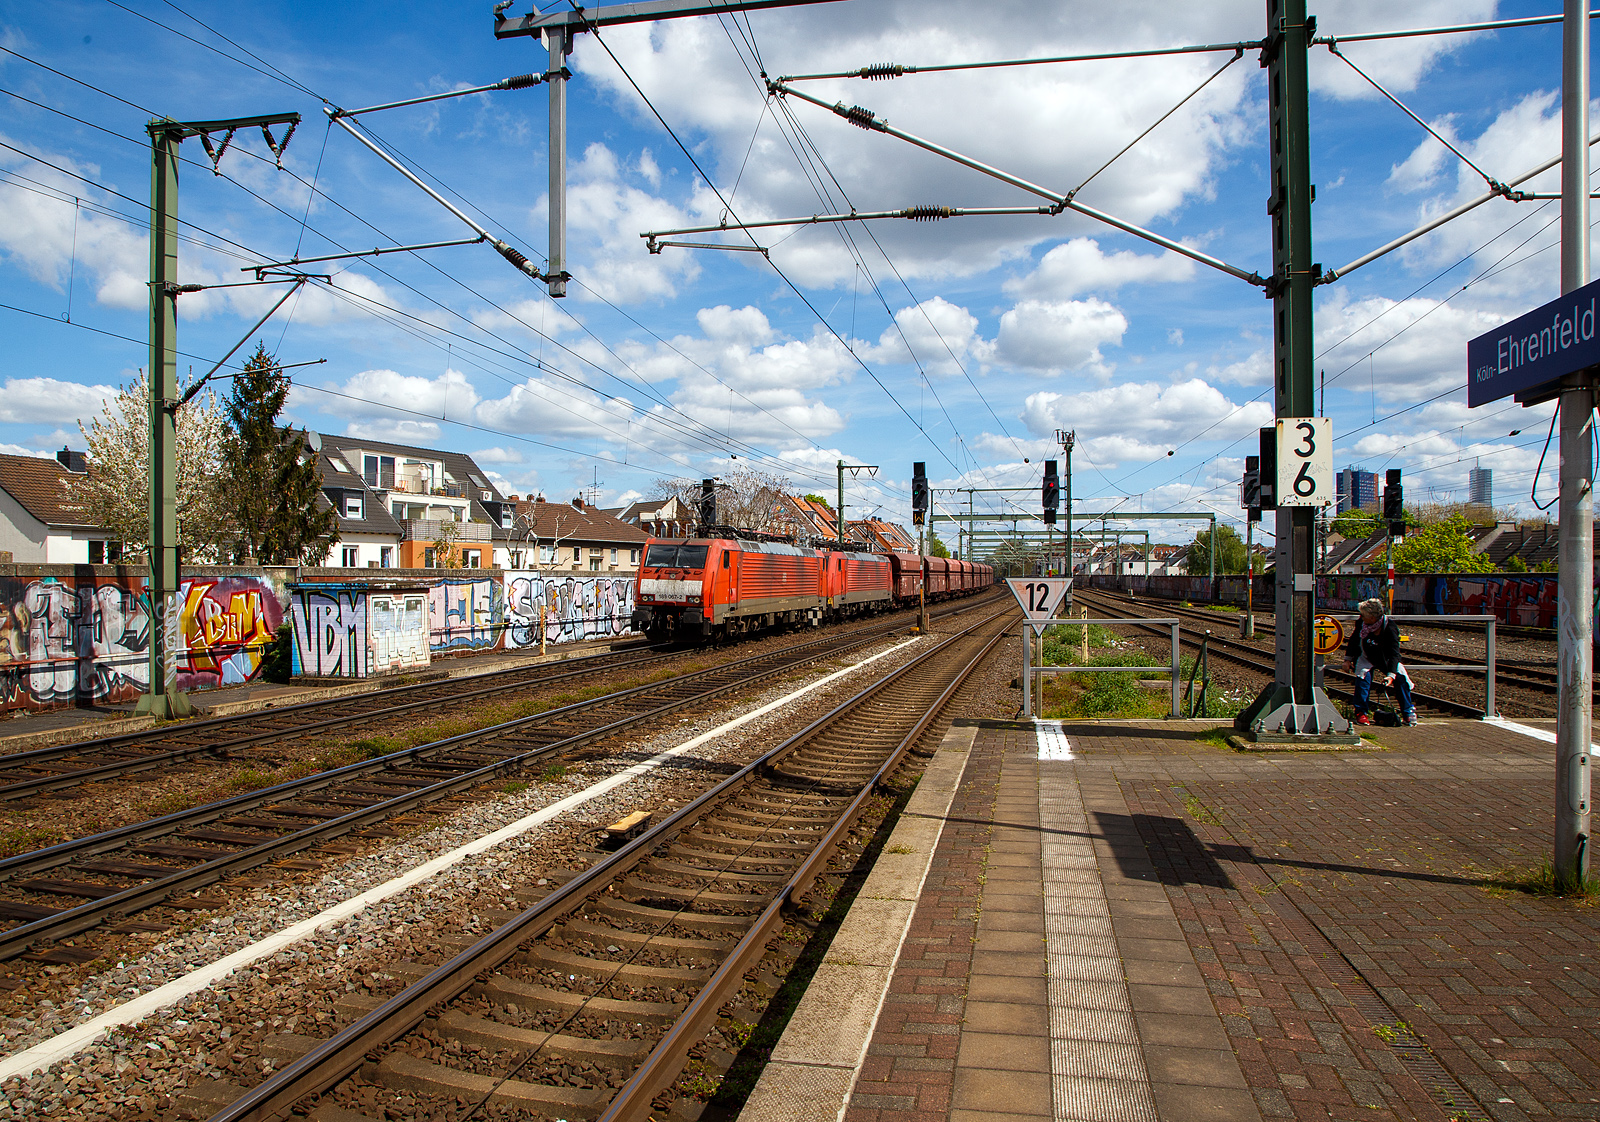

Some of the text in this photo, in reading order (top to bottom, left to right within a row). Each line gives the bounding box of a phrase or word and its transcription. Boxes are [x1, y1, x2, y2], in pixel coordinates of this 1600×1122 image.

[1476, 297, 1596, 383] Köln- Ehrenfeld
[1294, 422, 1315, 457] 3
[1293, 462, 1316, 496] 6
[1025, 583, 1050, 612] 12
[291, 589, 367, 679] VBM
